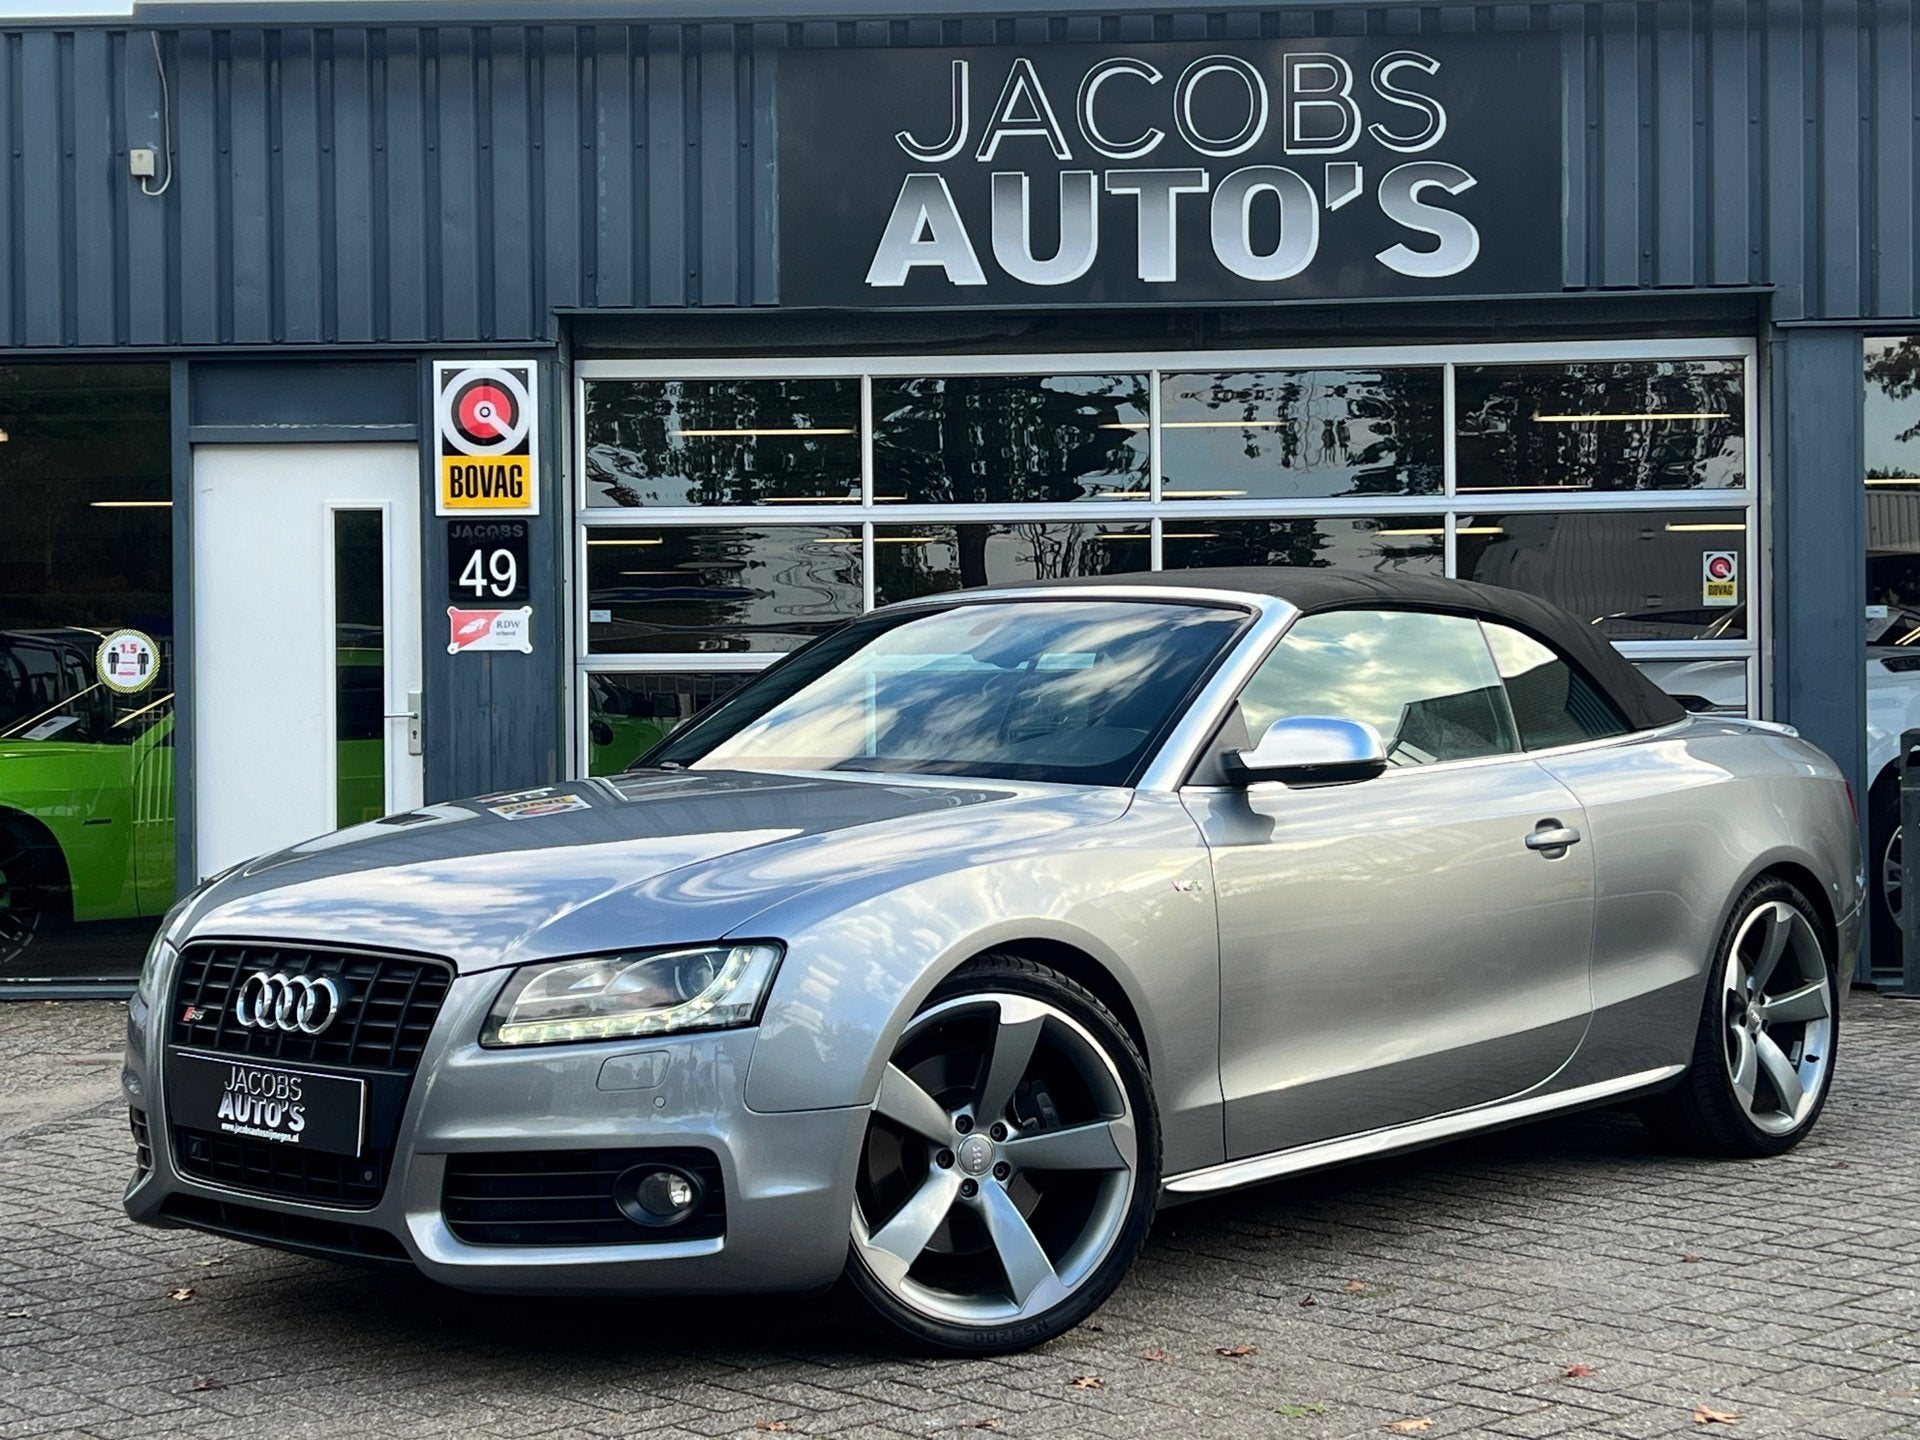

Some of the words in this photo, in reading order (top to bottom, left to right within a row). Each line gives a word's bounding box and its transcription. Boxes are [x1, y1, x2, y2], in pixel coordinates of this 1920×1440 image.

[895, 50, 1447, 162] JACOBS
[865, 161, 1481, 287] AUTO'S
[450, 464, 523, 498] BOVAG
[451, 524, 524, 538] JACOBS
[458, 548, 517, 597] 49
[1708, 584, 1734, 596] BOVAG
[496, 620, 520, 629] RDW
[120, 643, 138, 654] 1.5
[223, 1066, 302, 1101] JACOBS
[217, 1091, 305, 1132] AUTO'S
